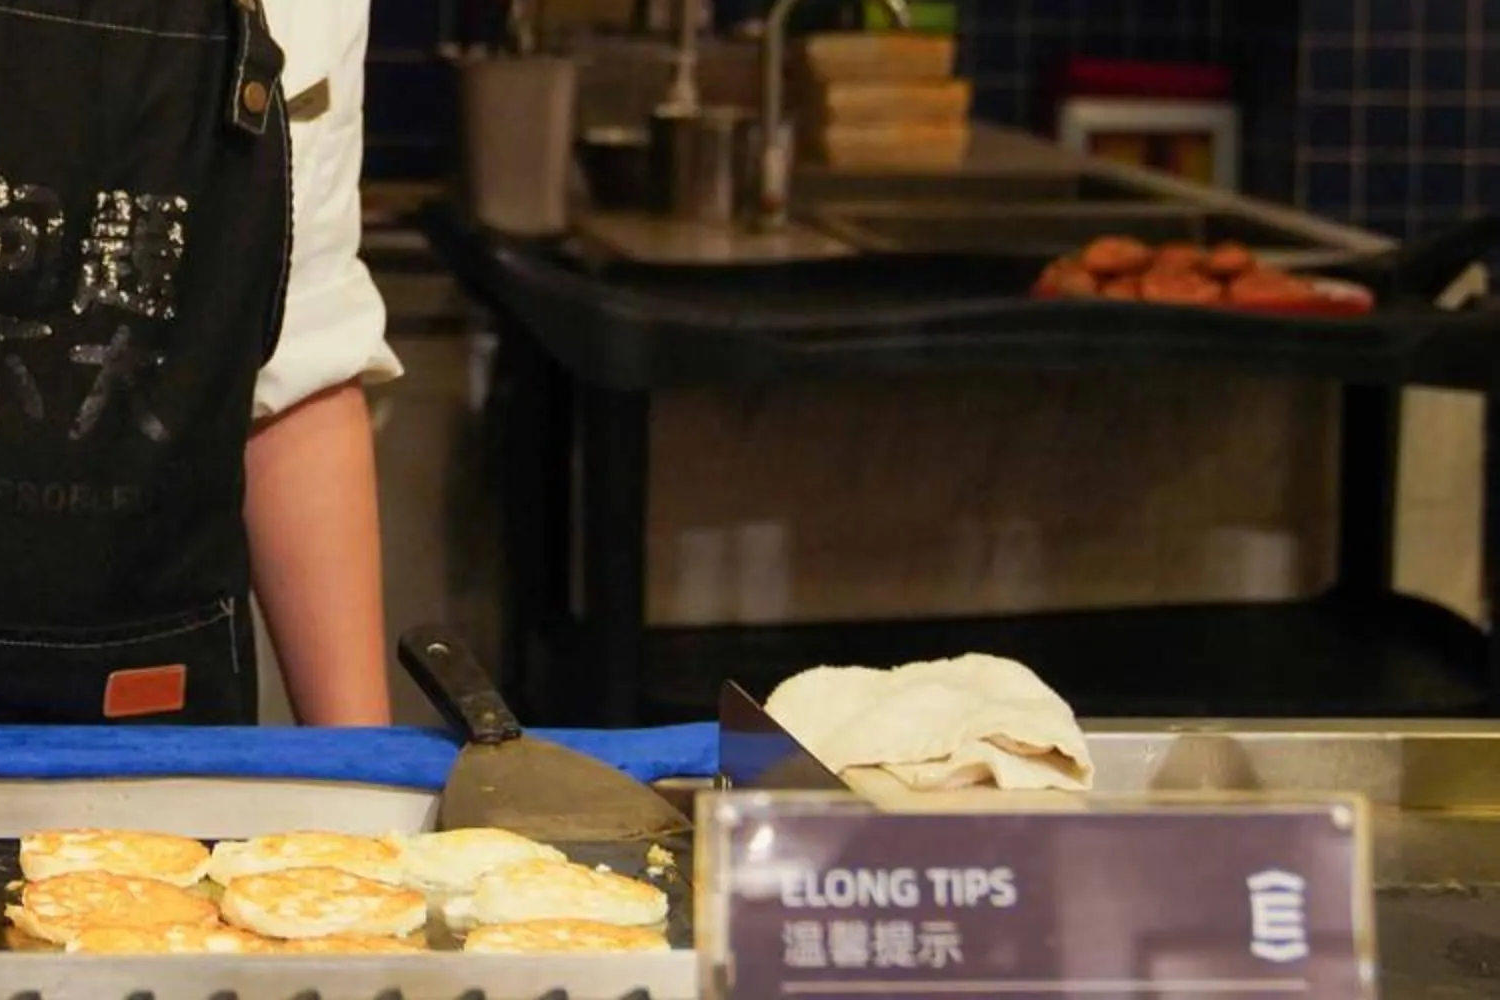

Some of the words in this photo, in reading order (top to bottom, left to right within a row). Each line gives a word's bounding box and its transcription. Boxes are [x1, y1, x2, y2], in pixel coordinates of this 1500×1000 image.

[780, 868, 921, 908] ELONG
[925, 867, 1018, 908] TIPS
[781, 919, 964, 969] 温馨提示
